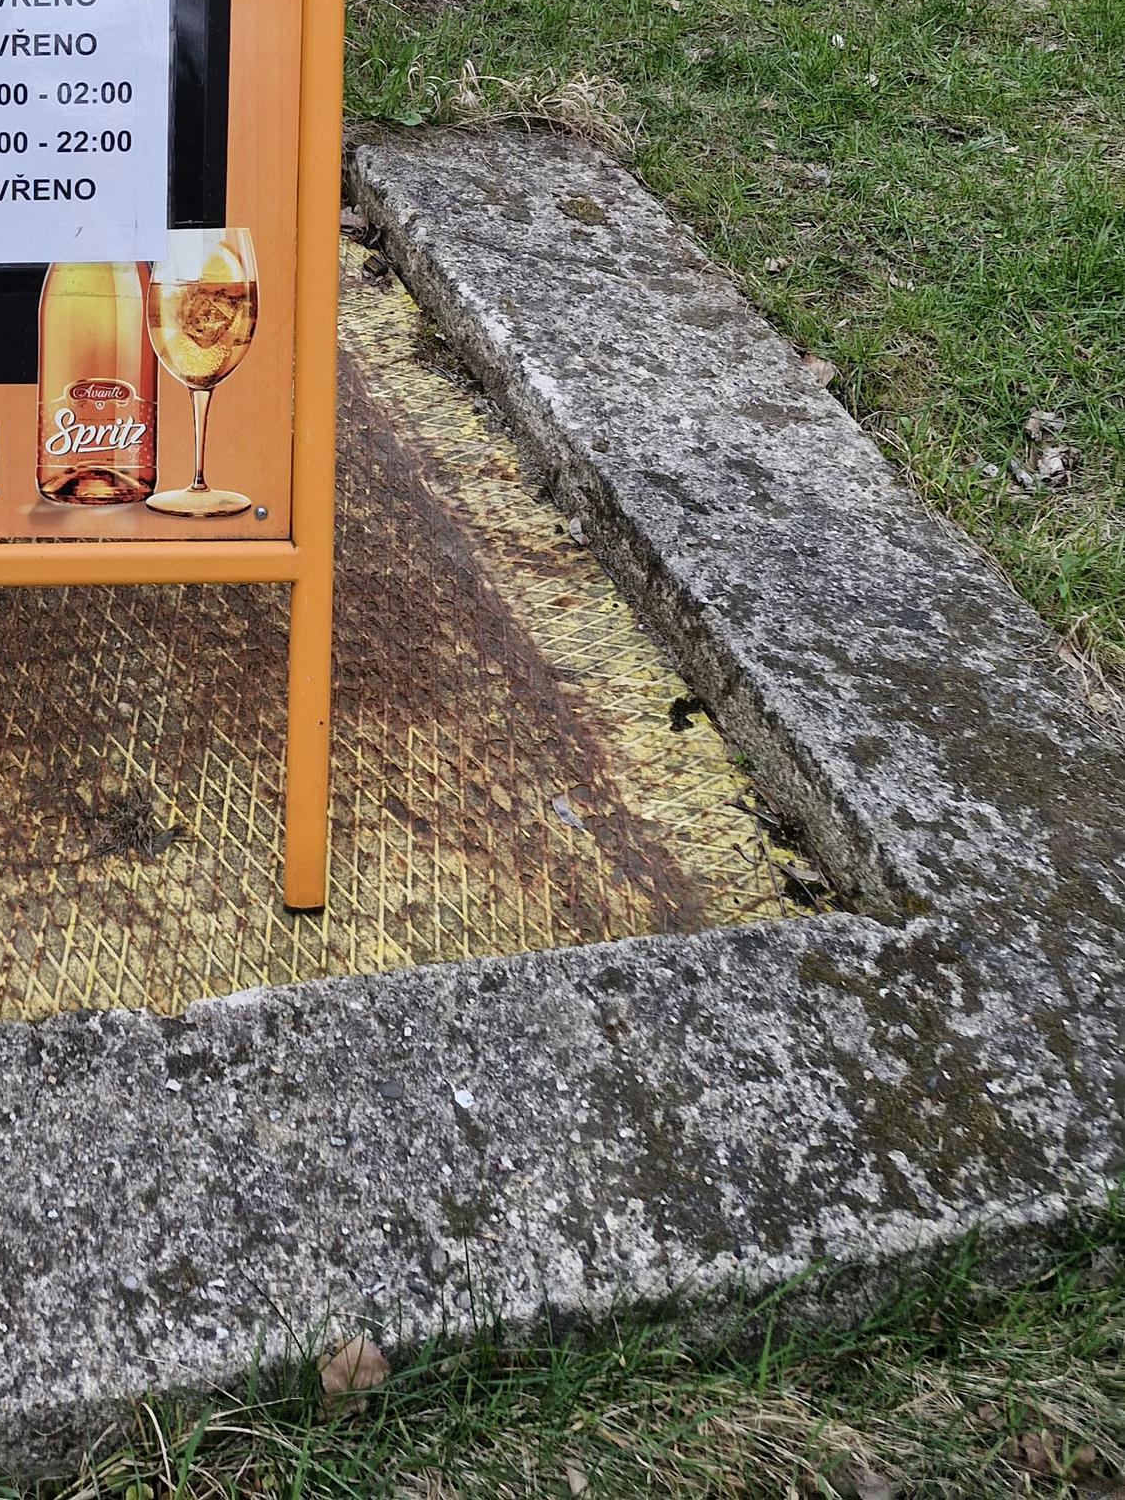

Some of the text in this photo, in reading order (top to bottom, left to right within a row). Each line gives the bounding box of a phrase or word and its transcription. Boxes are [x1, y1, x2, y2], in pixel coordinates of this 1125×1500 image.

[57, 81, 133, 105] 02:00
[56, 129, 133, 153] 22:00
[45, 407, 146, 456] Spritz
